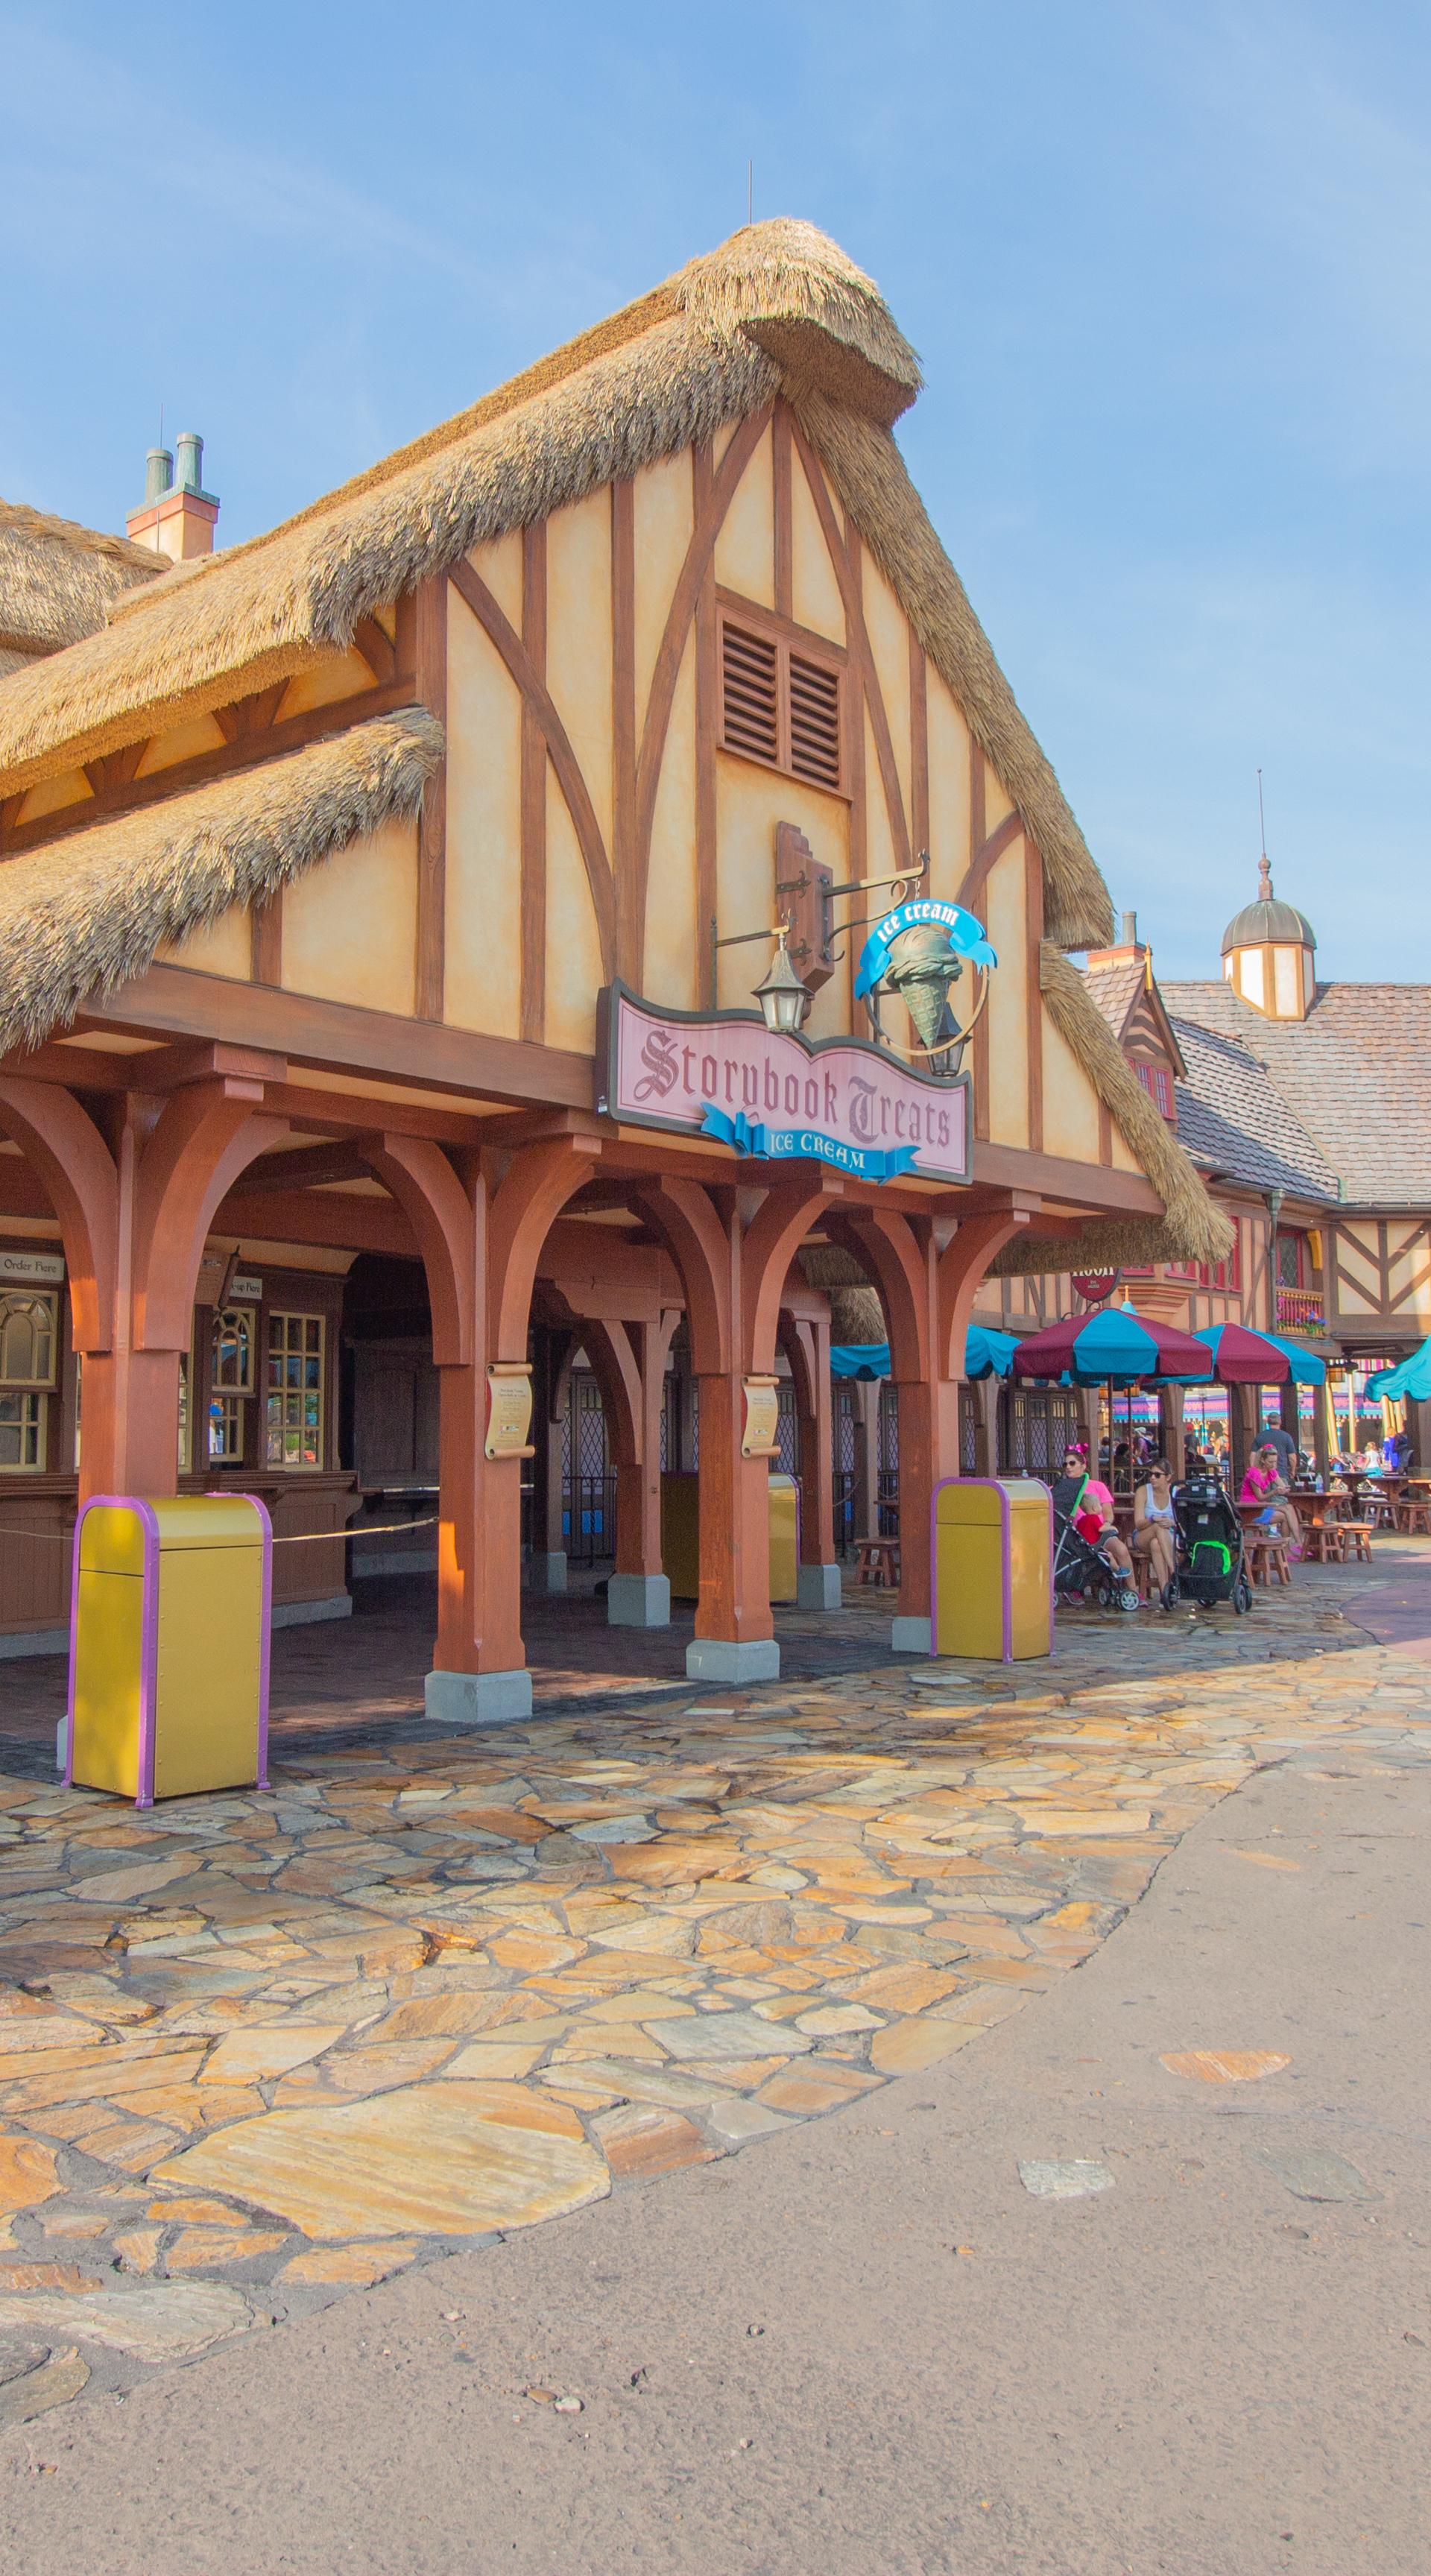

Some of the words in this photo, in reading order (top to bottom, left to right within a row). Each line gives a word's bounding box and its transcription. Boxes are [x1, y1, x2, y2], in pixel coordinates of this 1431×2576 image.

[877, 915, 900, 942] ice
[904, 903, 959, 926] cream
[634, 1030, 838, 1123] Storybook
[848, 1076, 950, 1148] Treats
[771, 1133, 794, 1152] ICE
[800, 1133, 865, 1169] CREAM
[4, 1259, 31, 1270] Order
[35, 1261, 57, 1272] Here
